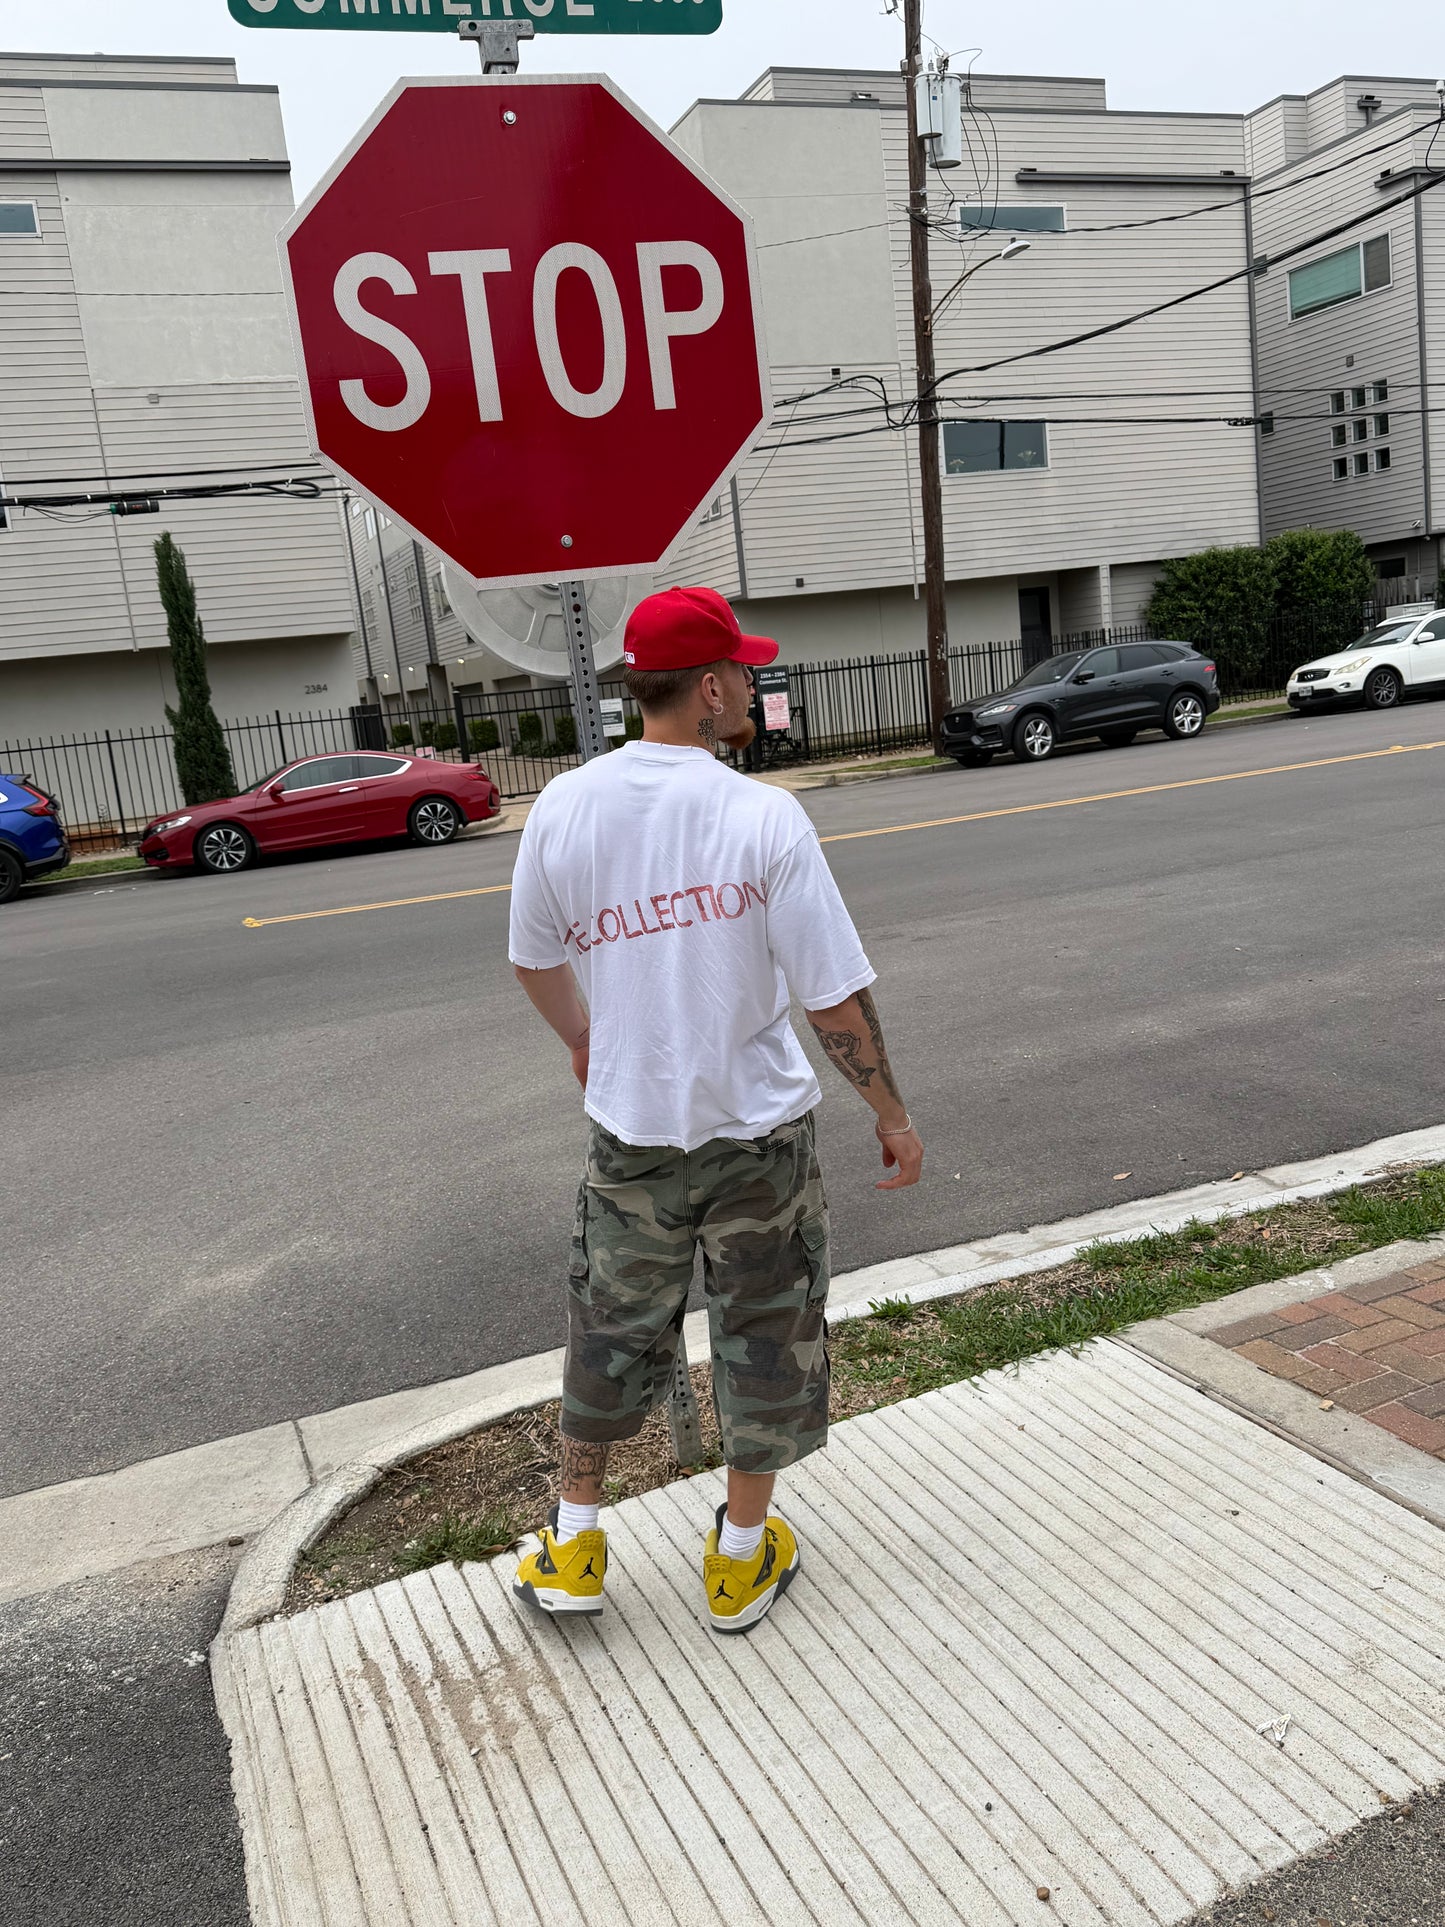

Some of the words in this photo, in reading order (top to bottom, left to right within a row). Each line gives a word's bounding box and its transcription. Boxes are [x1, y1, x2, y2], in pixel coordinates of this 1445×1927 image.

[333, 240, 724, 432] STOP
[304, 684, 328, 694] 2384
[563, 877, 768, 955] EOLLECTION
